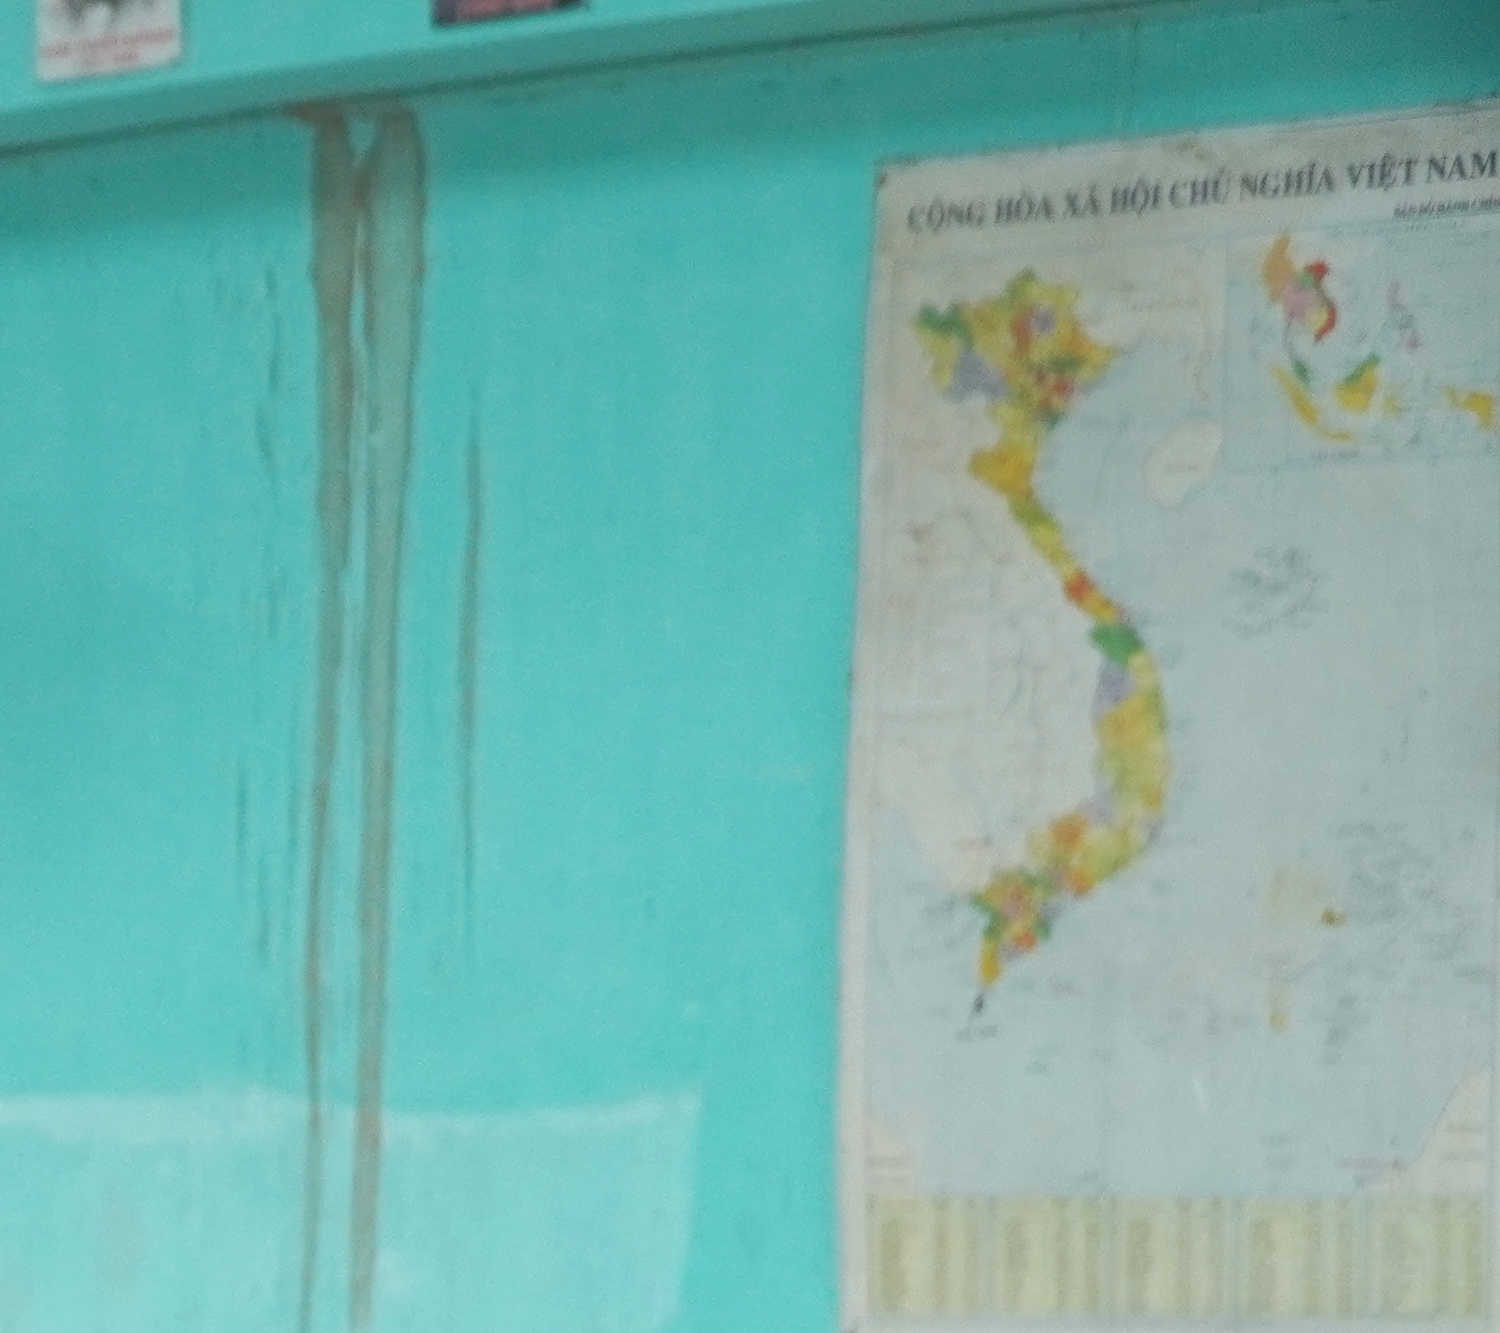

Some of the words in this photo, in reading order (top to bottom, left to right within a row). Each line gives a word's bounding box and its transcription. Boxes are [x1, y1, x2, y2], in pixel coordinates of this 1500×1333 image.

[907, 197, 985, 233] CỘNG
[995, 188, 1054, 223] HÒA
[1063, 183, 1102, 217] XÃ
[1111, 176, 1163, 216] HỘI
[1240, 160, 1336, 200] NGHĨA
[1347, 150, 1419, 191] VIỆT
[1427, 150, 1499, 184] NAM
